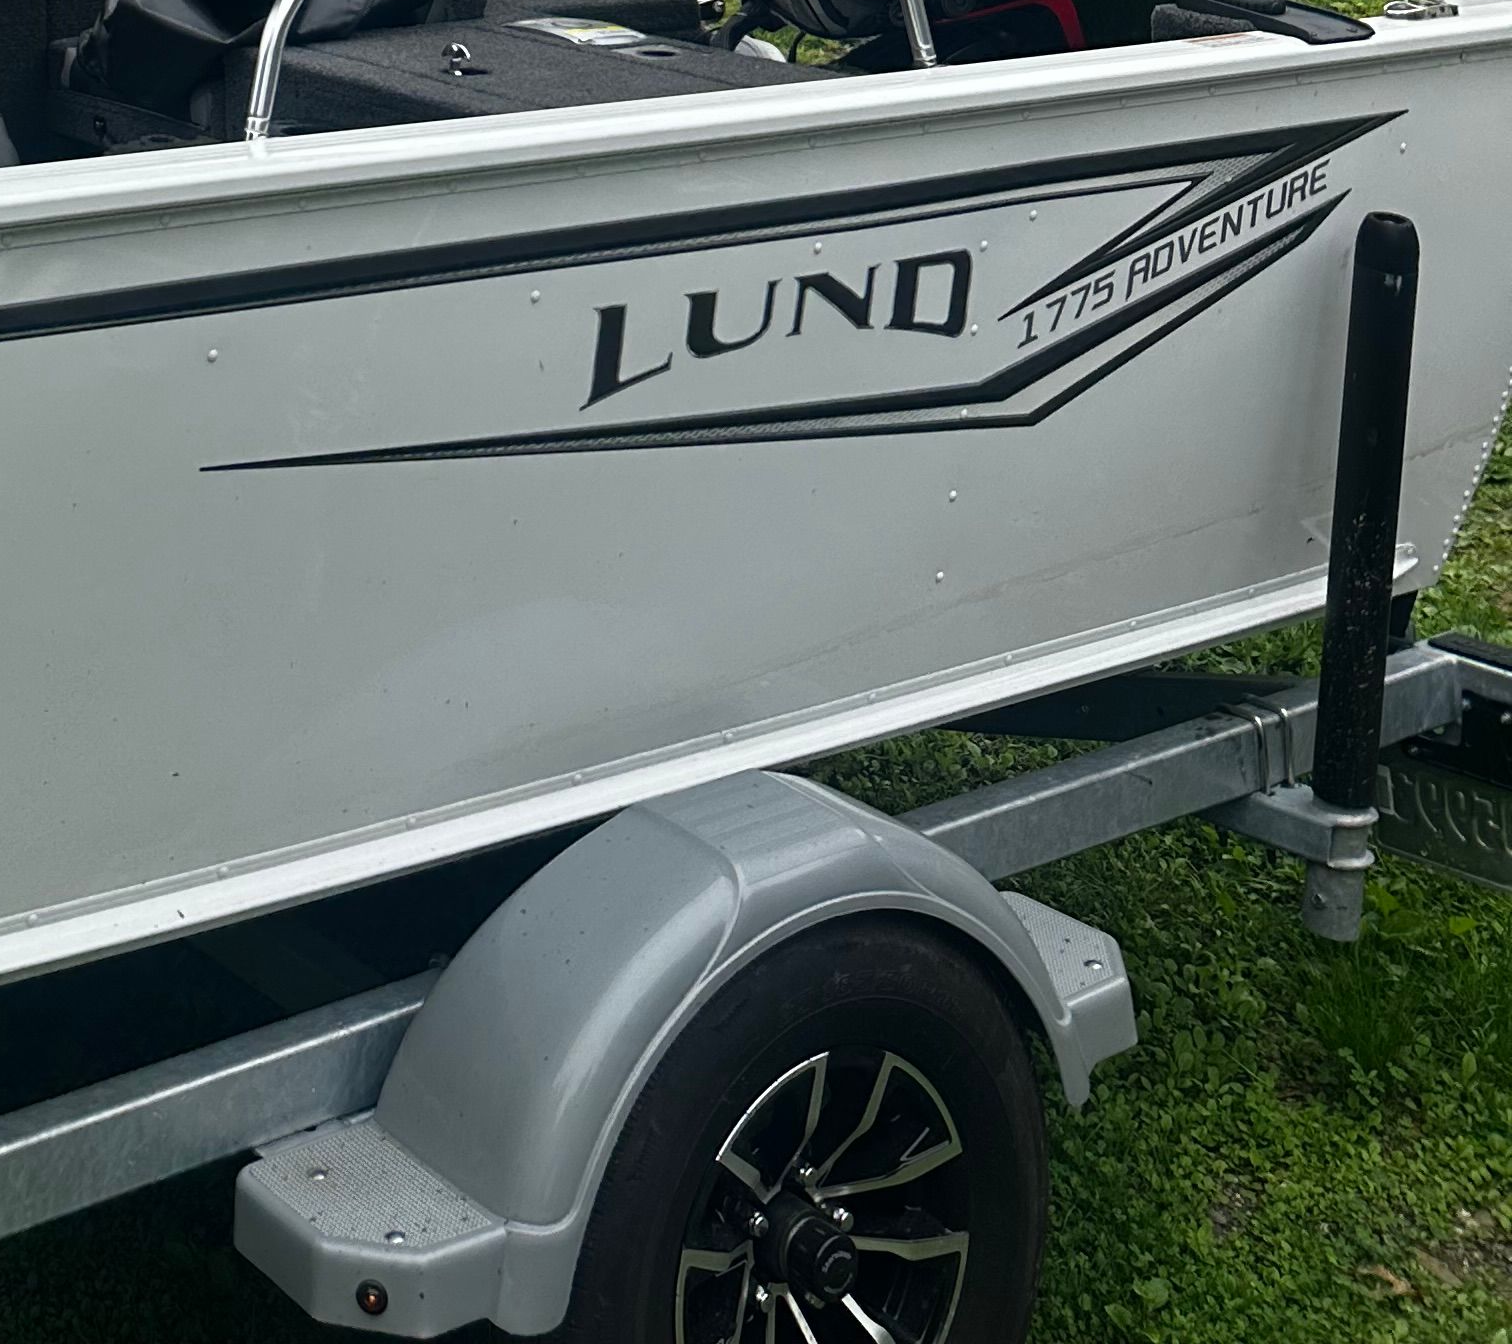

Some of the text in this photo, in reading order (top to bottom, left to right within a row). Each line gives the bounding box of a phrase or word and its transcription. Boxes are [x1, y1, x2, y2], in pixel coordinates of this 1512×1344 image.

[579, 248, 971, 411] LUND
[1017, 158, 1331, 349] 1775 ADVENTURE
